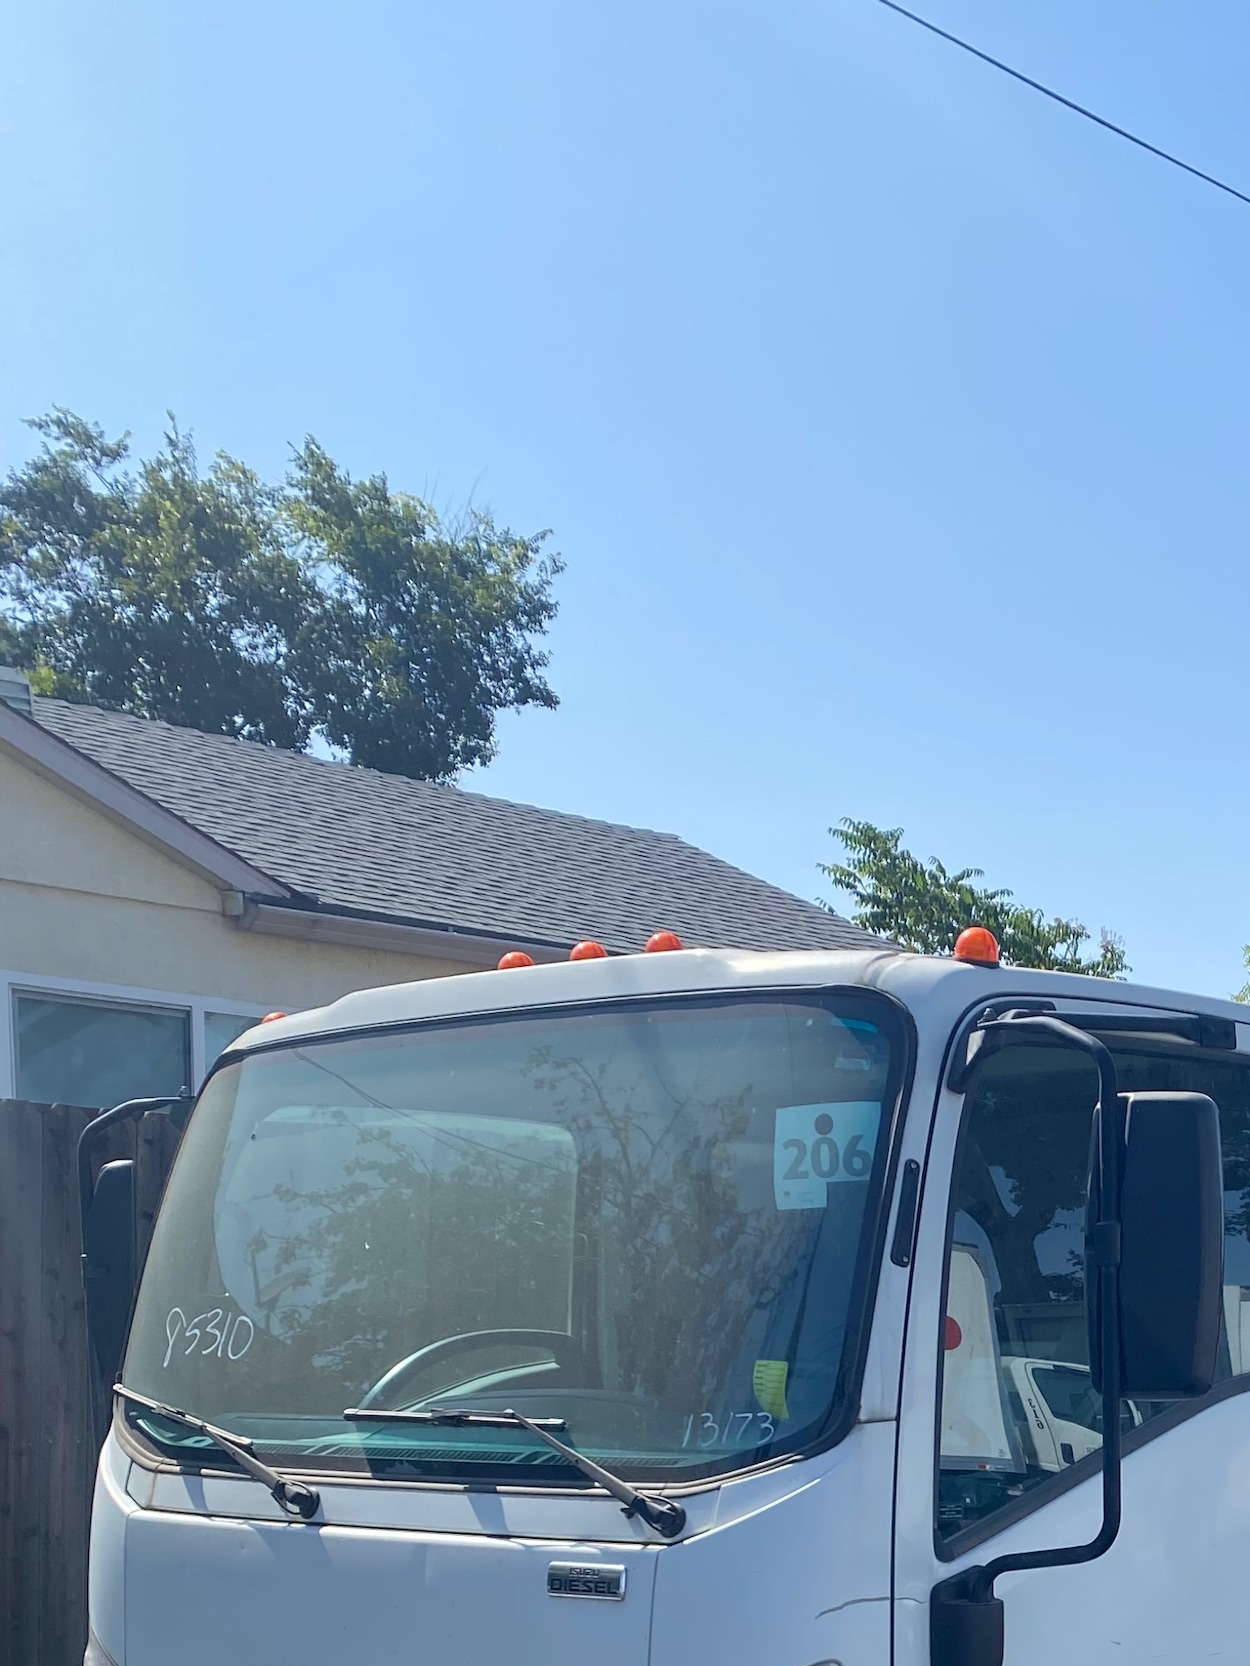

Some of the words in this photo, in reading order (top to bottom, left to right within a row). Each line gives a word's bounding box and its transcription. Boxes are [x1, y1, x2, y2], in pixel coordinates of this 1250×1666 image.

[782, 1134, 872, 1180] 206
[682, 1411, 775, 1447] 13173
[570, 1567, 600, 1577] ISUZU
[550, 1578, 618, 1595] DIESEL
